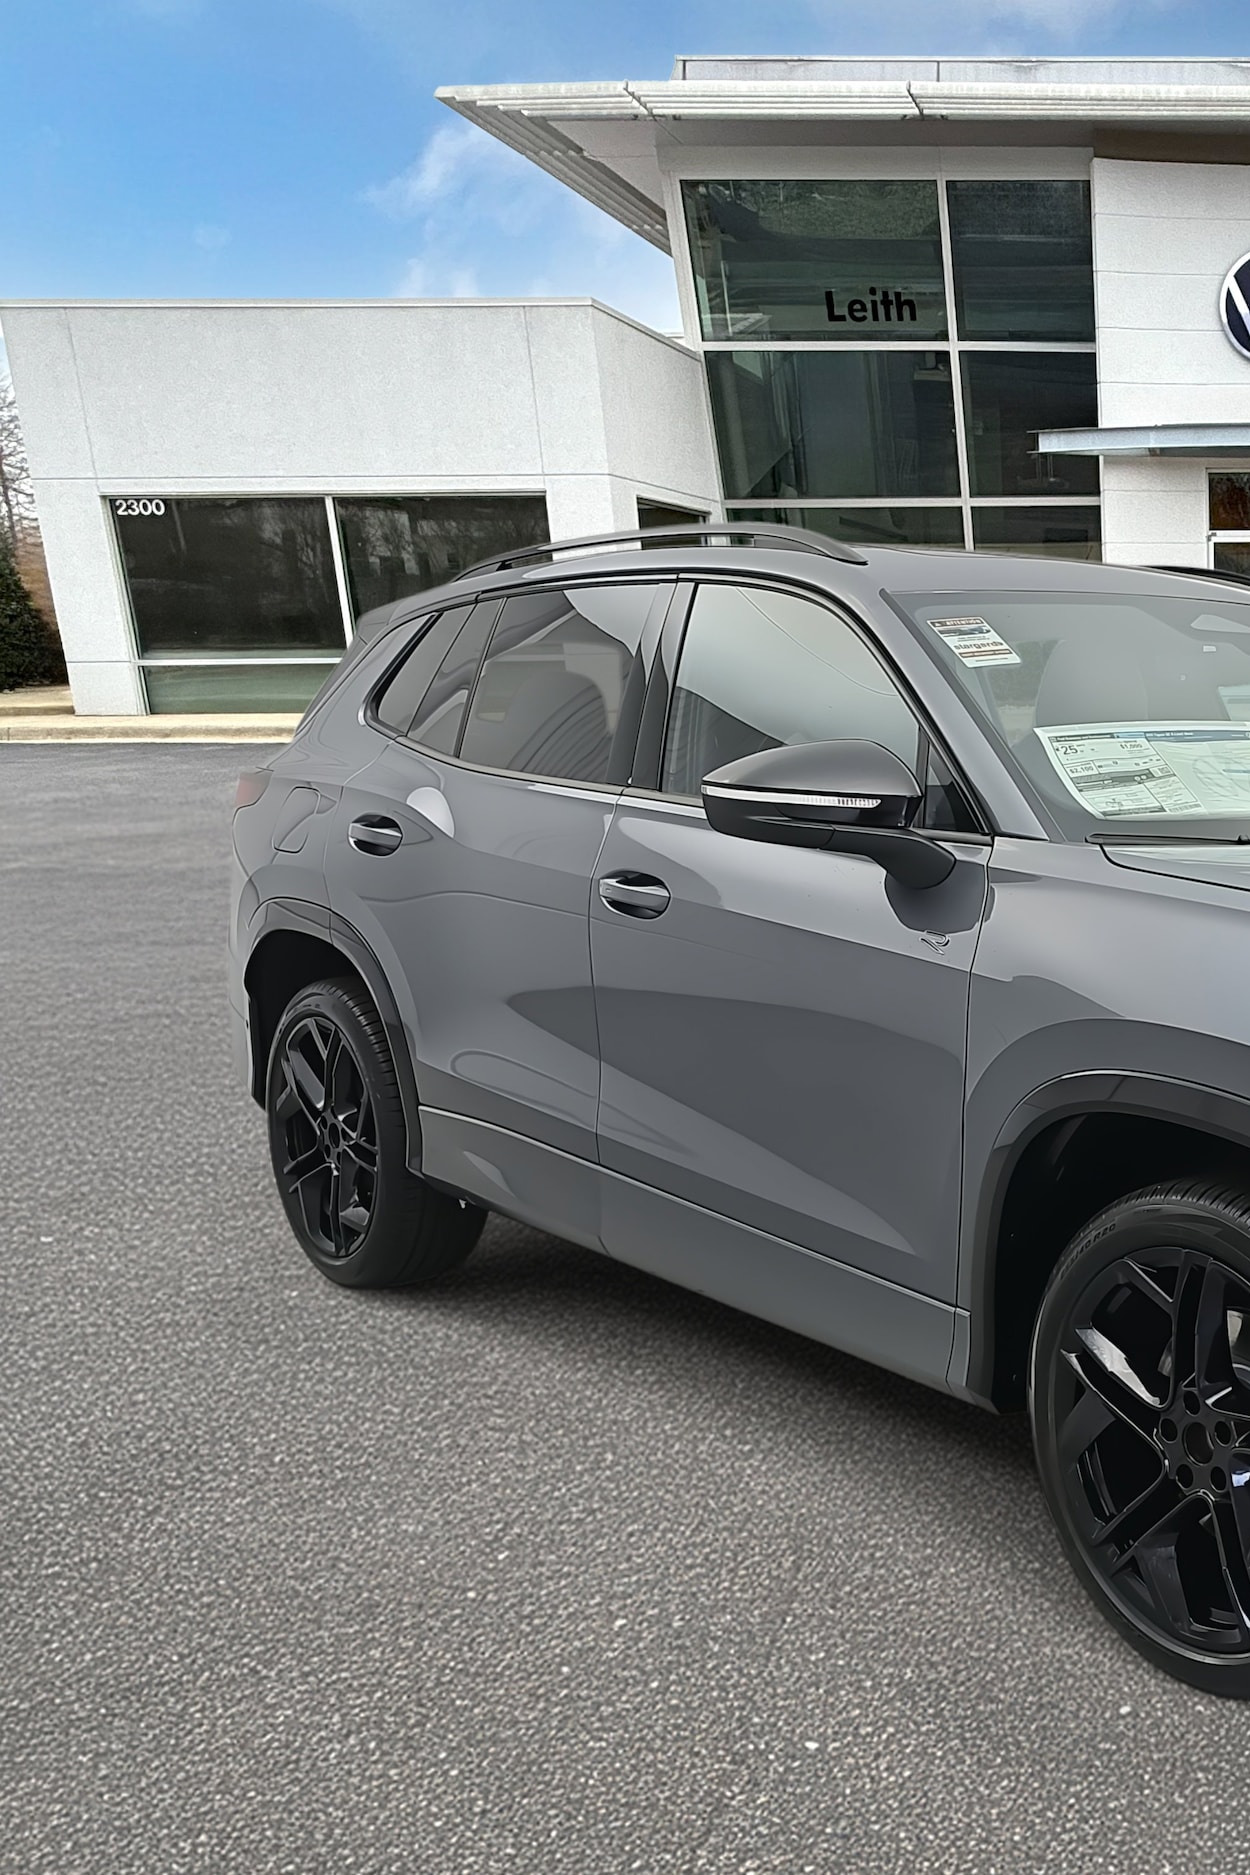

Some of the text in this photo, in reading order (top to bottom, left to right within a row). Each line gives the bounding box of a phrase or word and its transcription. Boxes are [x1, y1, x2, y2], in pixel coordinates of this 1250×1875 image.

[825, 286, 917, 323] Leith
[115, 499, 166, 516] 2300
[1060, 745, 1079, 755] 25
